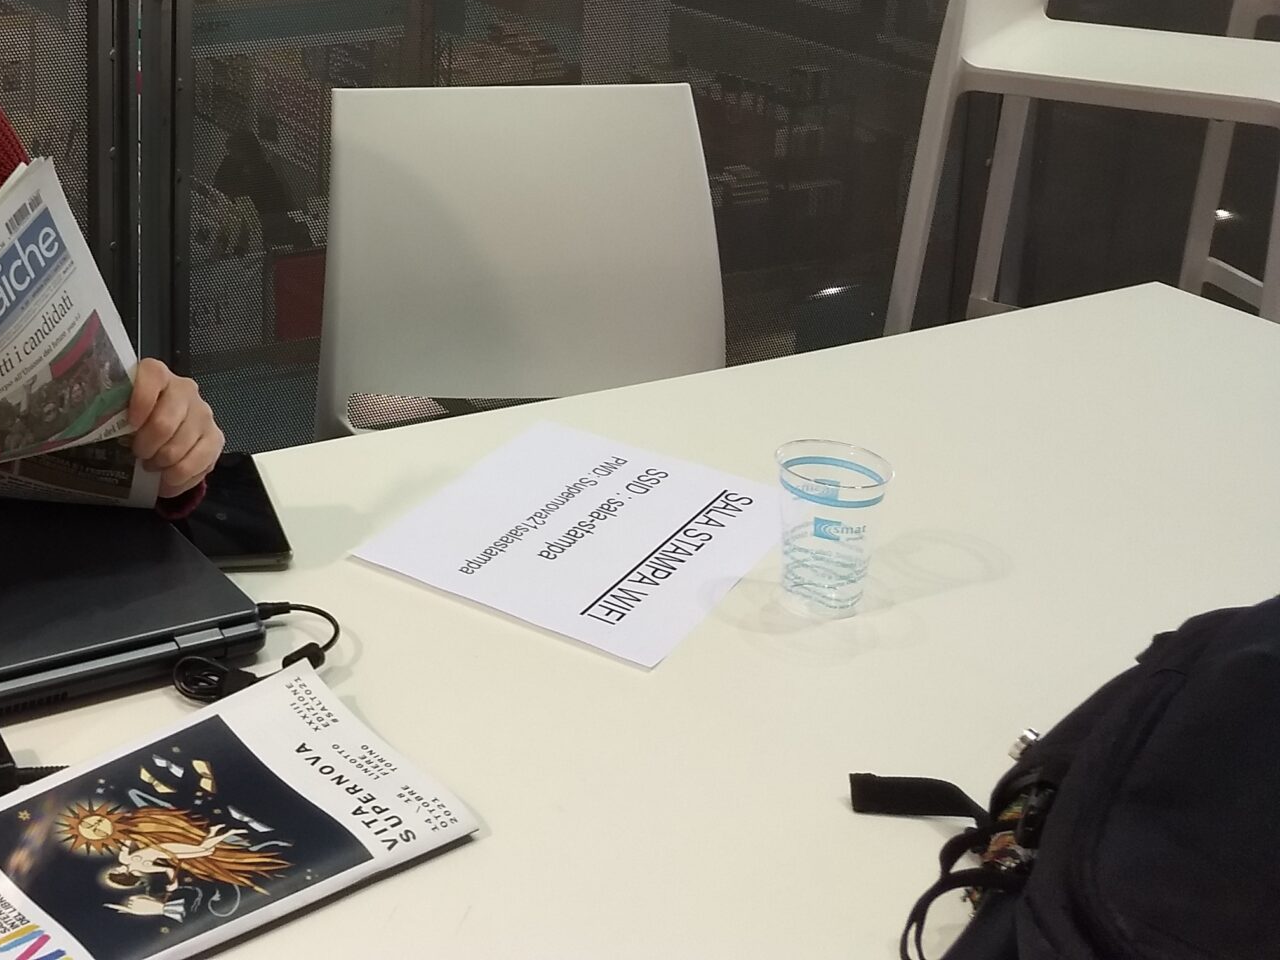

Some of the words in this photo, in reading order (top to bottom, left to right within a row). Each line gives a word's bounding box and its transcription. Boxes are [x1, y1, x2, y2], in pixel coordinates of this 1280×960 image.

[14, 345, 22, 363] i
[22, 289, 74, 356] candidati
[587, 456, 628, 479] PWD:
[626, 467, 669, 496] SSID
[458, 475, 598, 577] Supernova21salastampa
[537, 496, 625, 562] sala-stampa
[695, 491, 754, 530] SALA
[637, 527, 713, 587] STAMPA
[587, 585, 648, 626] WIFI
[285, 683, 331, 729] EDIZIONE
[290, 702, 323, 732] XXXIII
[293, 676, 339, 724] #SALTO21
[332, 744, 380, 781] LINGOTTO
[358, 754, 390, 777] FIERE
[360, 744, 399, 773] TORINO
[294, 742, 417, 844] SUPERNOVA
[396, 792, 412, 804] 18
[400, 784, 449, 828] OTTOBRE
[430, 796, 459, 824] 2021
[350, 805, 399, 851] VITA
[424, 818, 439, 832] 14
[14, 911, 31, 926] DEL
